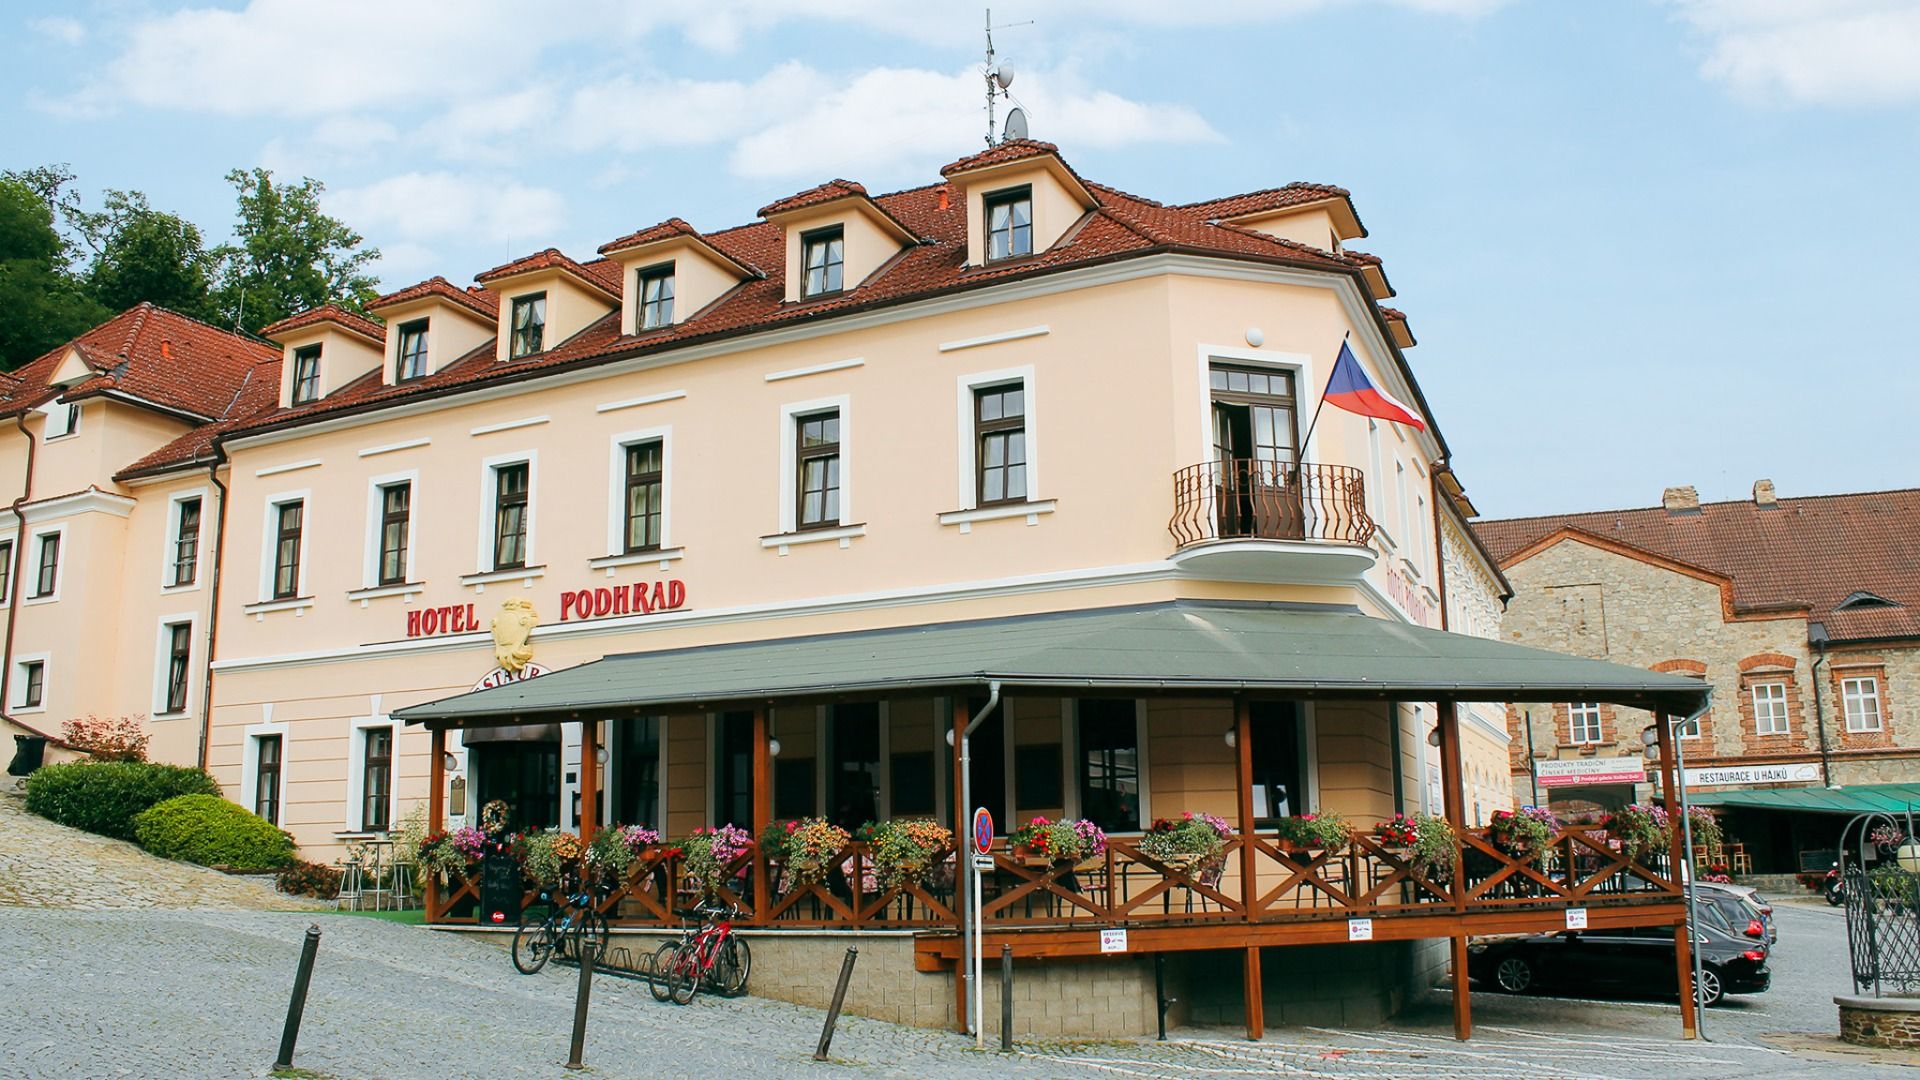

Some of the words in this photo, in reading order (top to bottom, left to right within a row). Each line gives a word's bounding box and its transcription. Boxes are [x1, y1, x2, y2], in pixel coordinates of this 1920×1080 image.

[406, 603, 479, 637] HOTEL
[560, 579, 686, 621] PODHRAD
[1541, 761, 1575, 769] PRODUKTY
[1699, 771, 1750, 783] RESTAURACE
[1754, 772, 1760, 781] U
